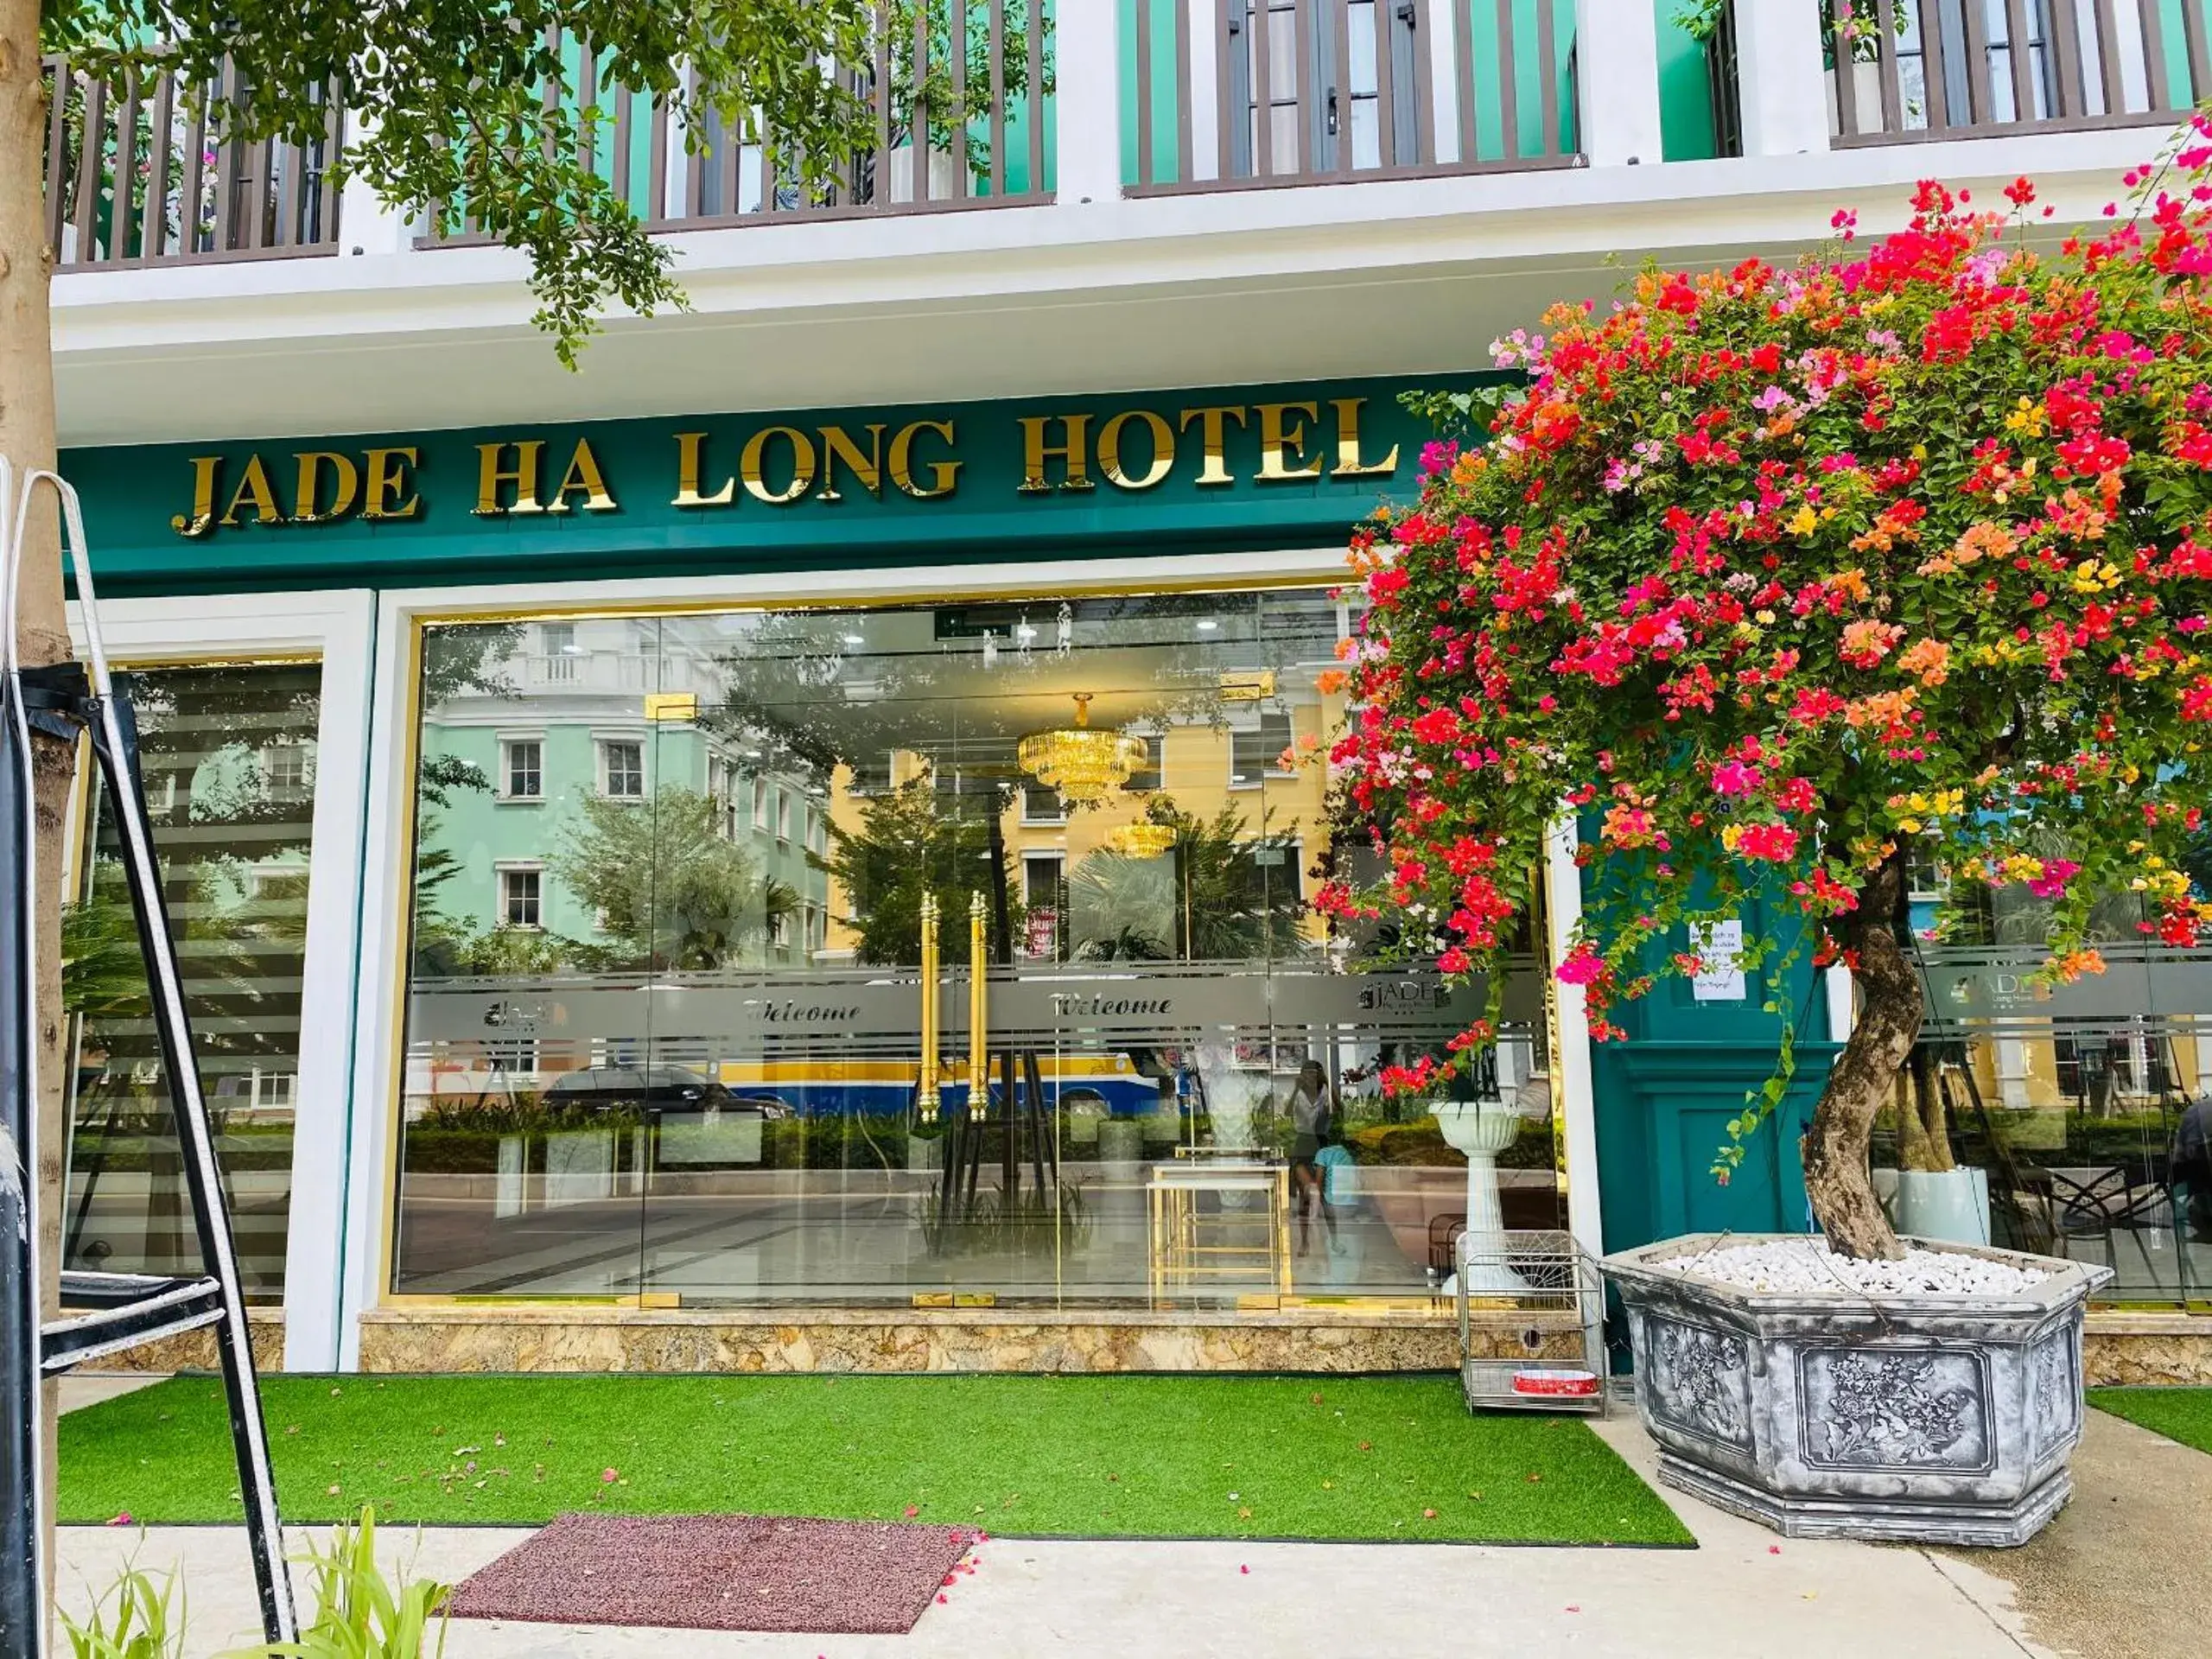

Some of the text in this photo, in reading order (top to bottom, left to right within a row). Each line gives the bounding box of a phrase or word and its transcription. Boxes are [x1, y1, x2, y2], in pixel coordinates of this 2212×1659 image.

[170, 397, 1400, 538] JADE HA LONG HOTEL
[1048, 992, 1173, 1015] Welcome
